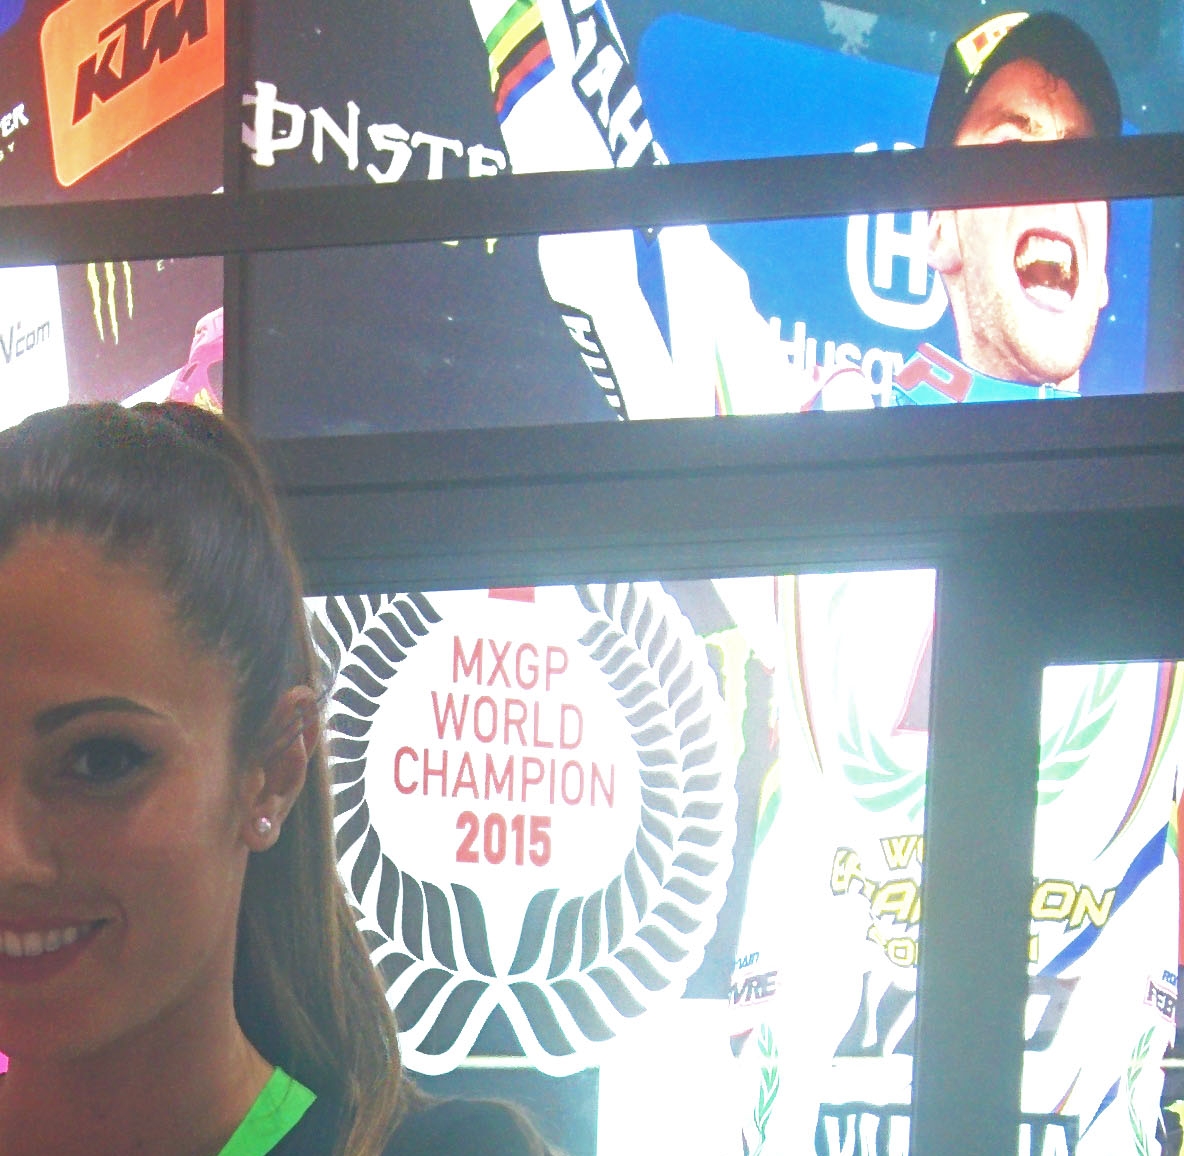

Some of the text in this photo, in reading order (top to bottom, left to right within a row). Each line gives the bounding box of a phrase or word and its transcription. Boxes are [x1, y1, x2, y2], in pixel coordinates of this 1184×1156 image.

[72, 0, 209, 126] KTM
[452, 635, 570, 692] MXGP
[430, 690, 584, 751] WORLD
[393, 745, 616, 810] CHAMPION
[454, 810, 552, 868] 2015
